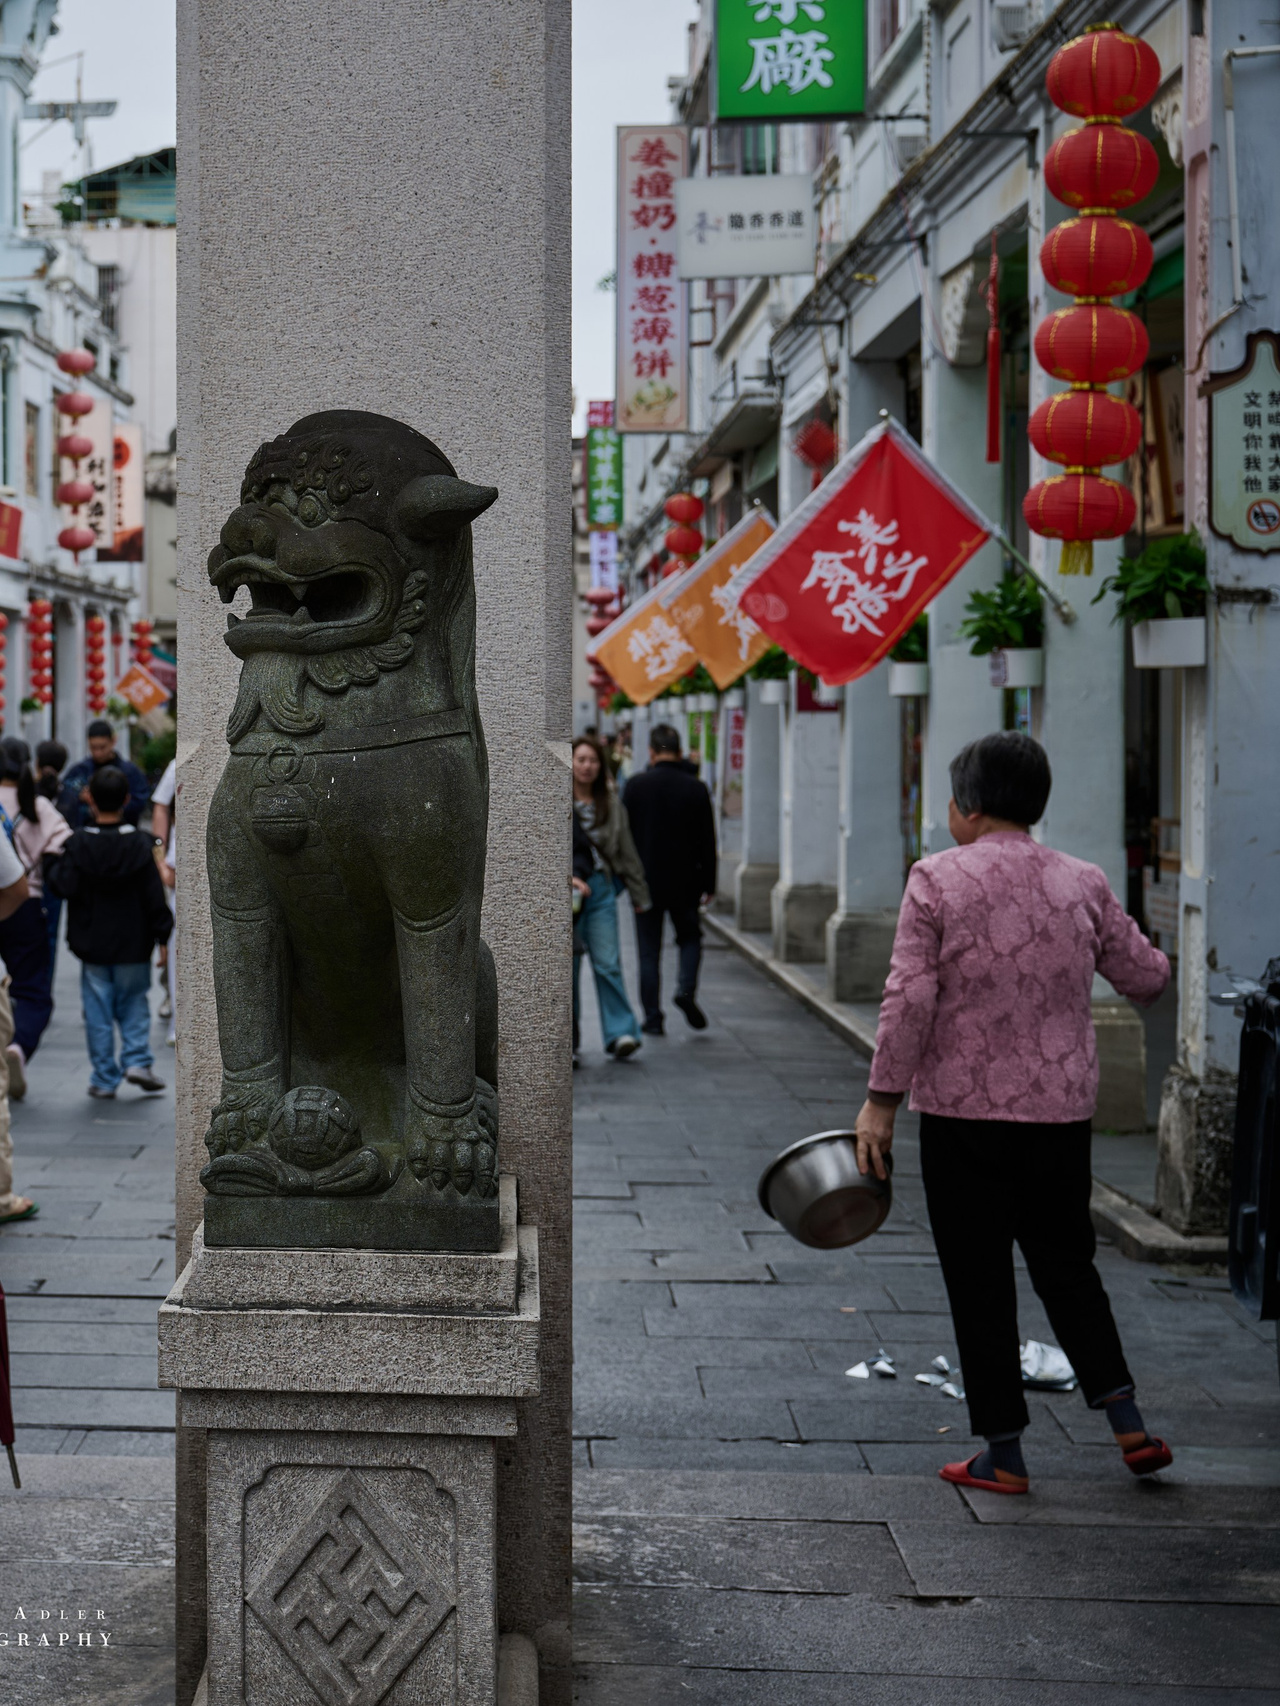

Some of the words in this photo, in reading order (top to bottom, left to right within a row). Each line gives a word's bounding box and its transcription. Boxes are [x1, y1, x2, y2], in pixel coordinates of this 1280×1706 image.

[1243, 391, 1262, 493] 文明你我他
